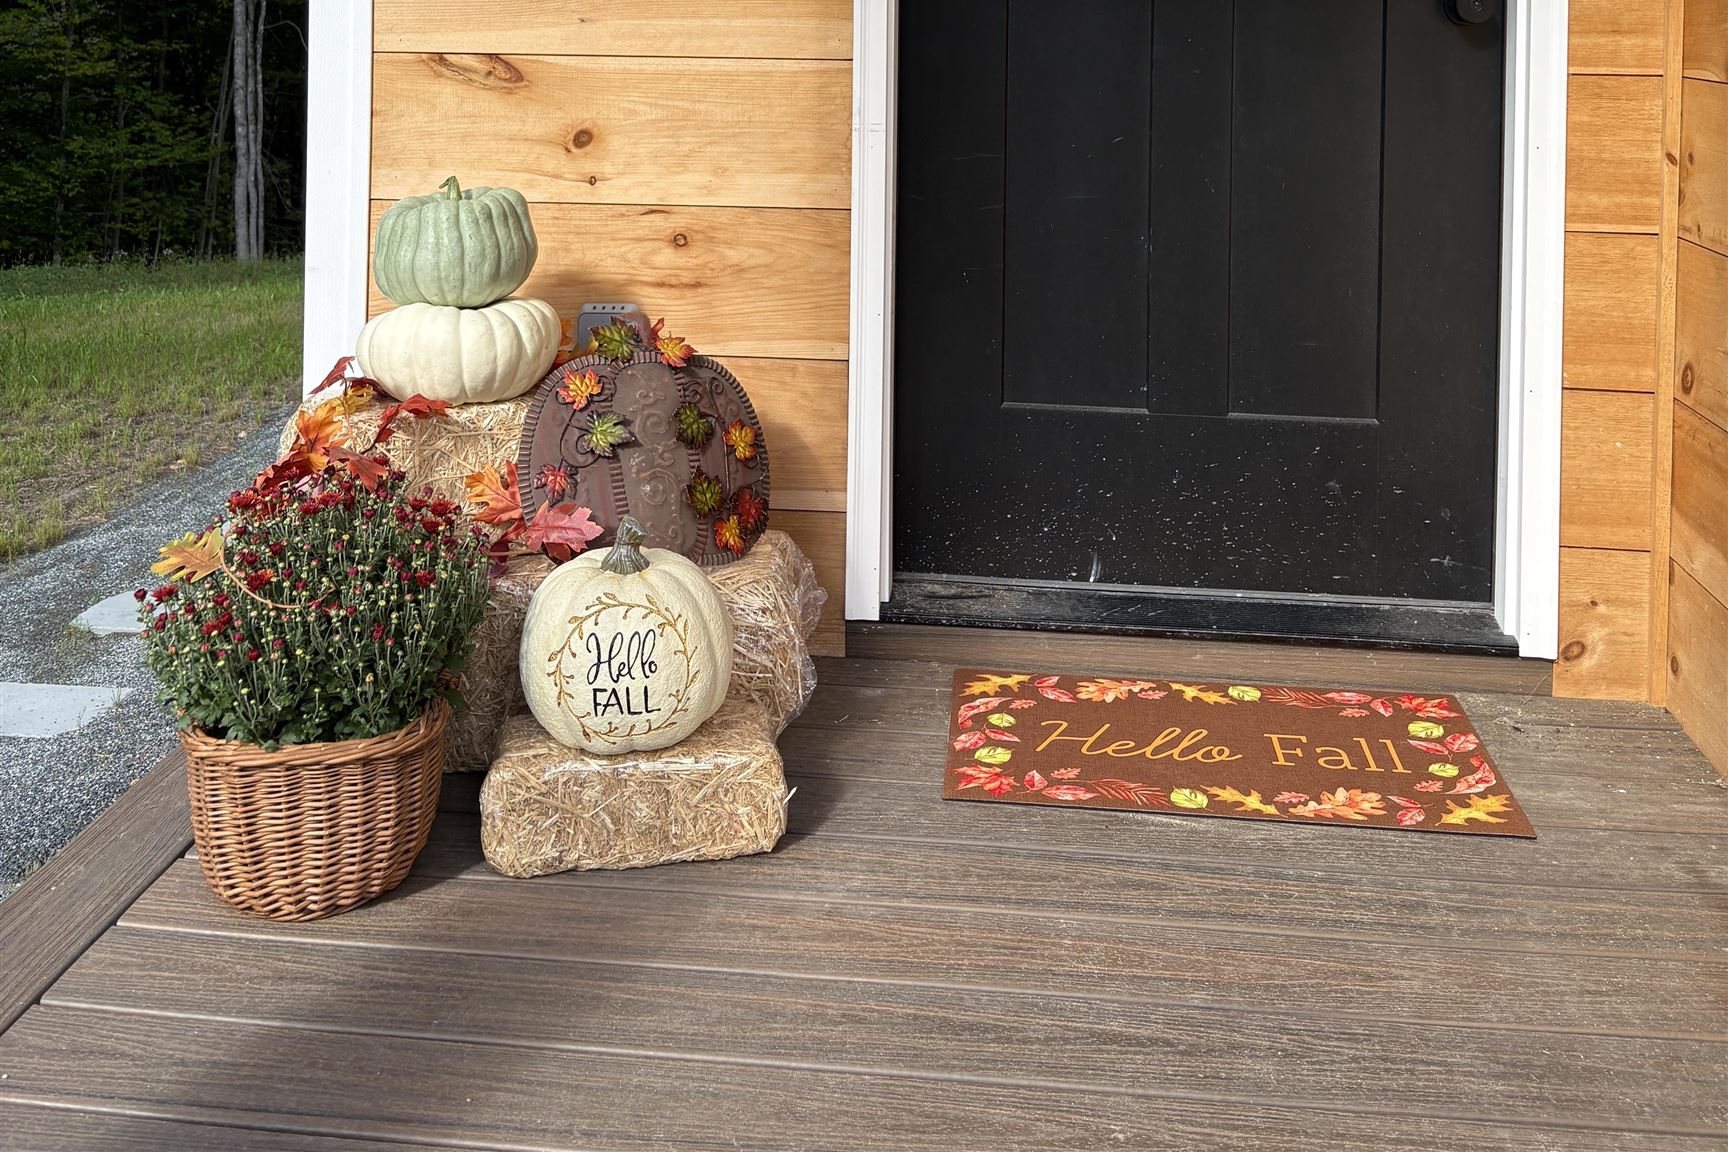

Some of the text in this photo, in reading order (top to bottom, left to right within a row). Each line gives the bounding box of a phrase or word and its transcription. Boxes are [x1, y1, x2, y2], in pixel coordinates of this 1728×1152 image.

[586, 629, 657, 685] Hello
[592, 685, 661, 717] FALL
[1035, 720, 1411, 774] Hello Fall
